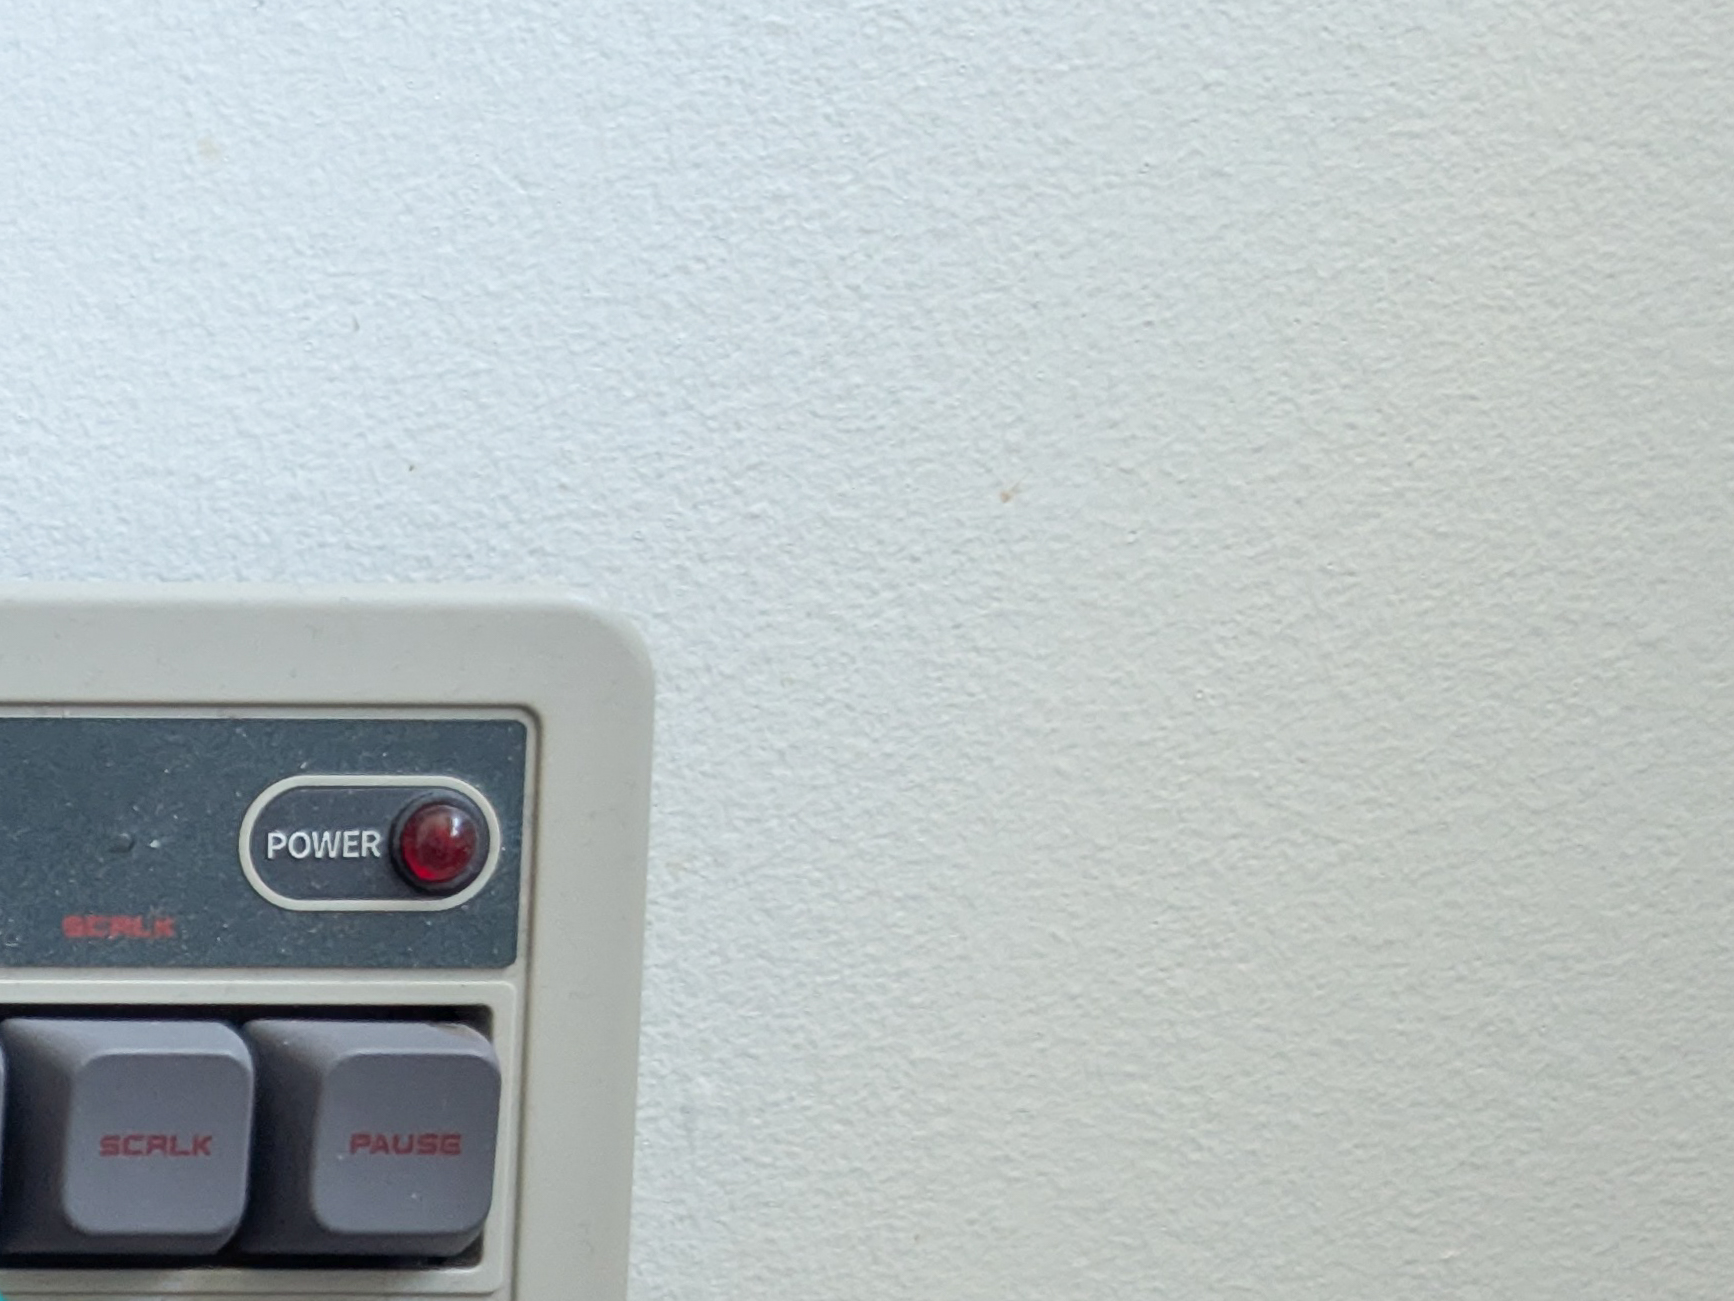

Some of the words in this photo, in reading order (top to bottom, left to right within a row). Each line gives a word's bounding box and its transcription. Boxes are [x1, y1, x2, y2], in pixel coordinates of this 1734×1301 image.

[266, 830, 382, 859] POWER
[99, 1133, 213, 1157] SCRLK
[348, 1132, 463, 1156] PAUSE
